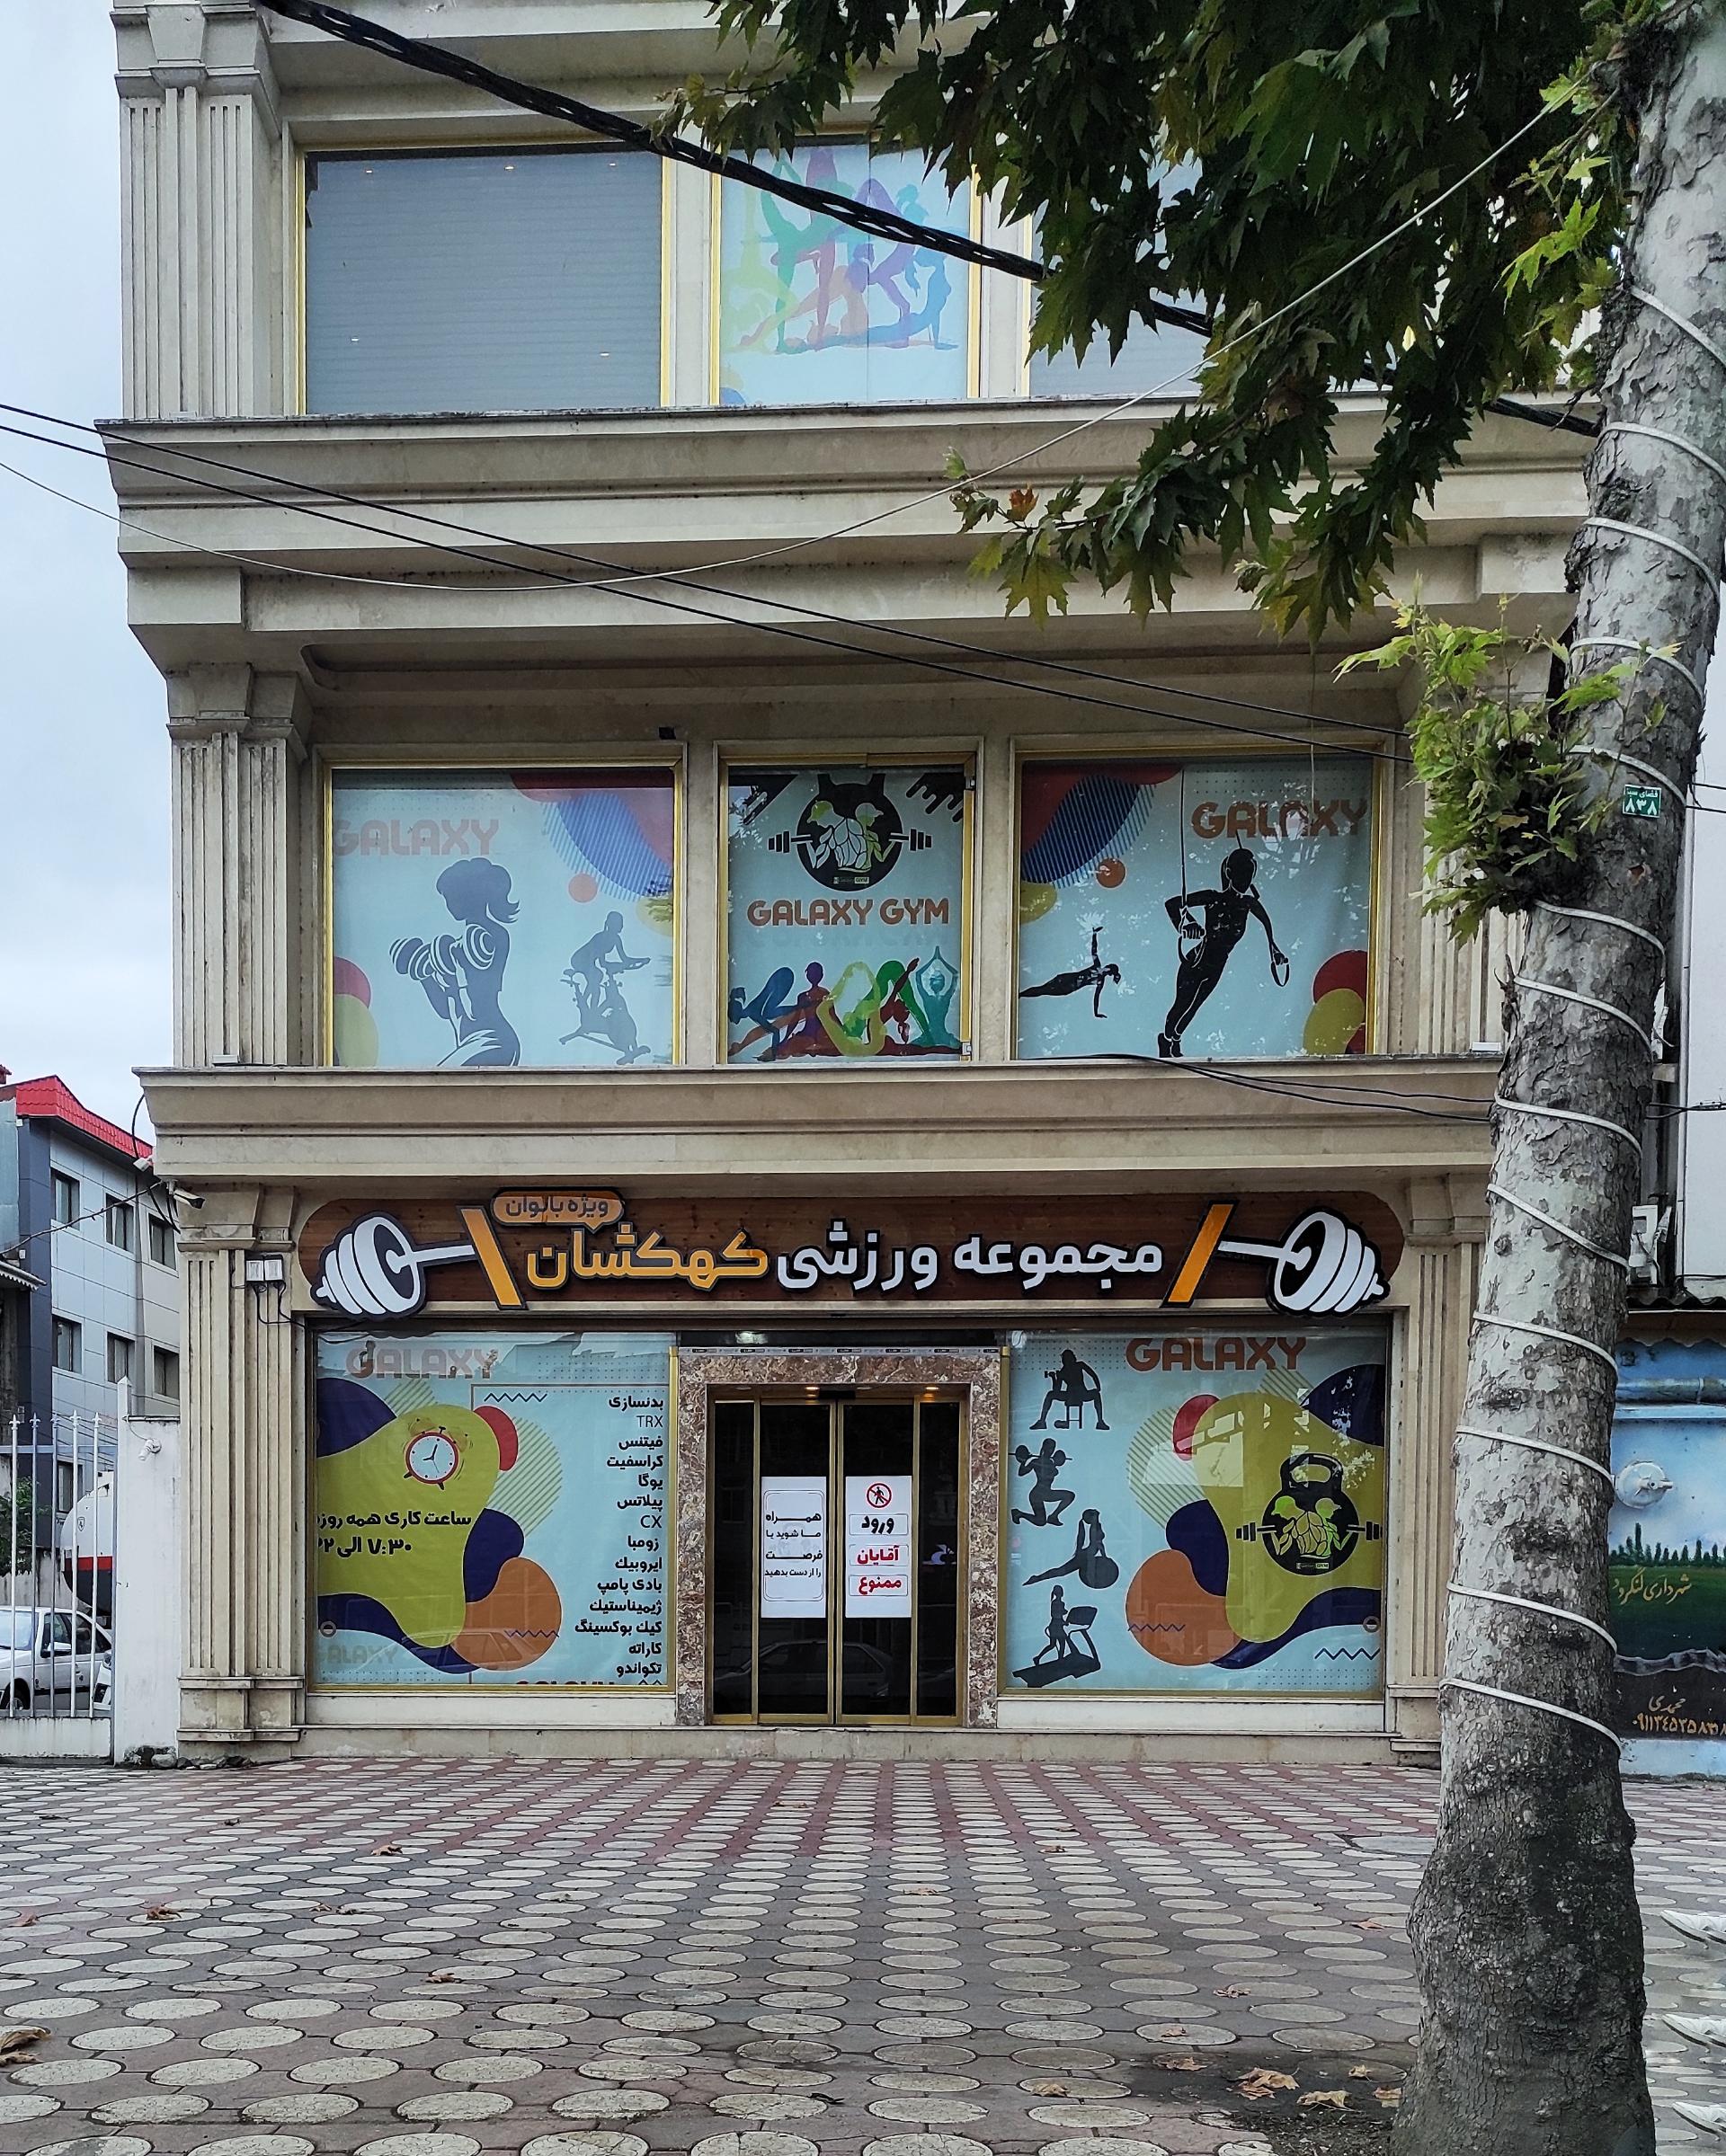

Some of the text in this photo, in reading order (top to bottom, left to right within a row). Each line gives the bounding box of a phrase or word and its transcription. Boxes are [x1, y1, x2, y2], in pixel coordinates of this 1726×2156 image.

[1625, 798, 1657, 815] ۸۳۸
[1191, 799, 1367, 838] GALAXY
[334, 819, 499, 856] GALAXY
[747, 898, 949, 926] GALAXY GYM
[567, 1193, 609, 1218] ویژه
[527, 1220, 1163, 1291] مجموعه ورزشی کهکشان
[1125, 1337, 1307, 1371] GALAXY
[346, 1348, 497, 1379] GALAXY
[609, 1396, 664, 1412] بدنسازی
[636, 1415, 663, 1428] TRX
[618, 1435, 663, 1451] فیتنس
[606, 1454, 664, 1470] کراسفیت
[637, 1473, 663, 1491] یوگا
[617, 1495, 663, 1512] پیلاتس
[346, 1513, 381, 1528] همه
[384, 1510, 422, 1530] کاری
[424, 1510, 472, 1525] ساعت
[640, 1515, 663, 1529] CX
[765, 1511, 822, 1524] همراه
[861, 1515, 894, 1534] ورود
[766, 1529, 822, 1539] ما شوید یا
[336, 1536, 362, 1558] الی
[367, 1538, 412, 1556] ۷:۳۰
[627, 1535, 659, 1551] زومبا
[765, 1549, 823, 1563] فرصت
[857, 1545, 900, 1566] آقایان
[764, 1569, 788, 1577] بدهید
[807, 1567, 814, 1577] از
[815, 1567, 822, 1577] را
[597, 1577, 663, 1595] بادی پامپ
[859, 1575, 902, 1594] ممنوع
[1612, 1566, 1692, 1605] شهرداری لنگرود
[574, 1619, 633, 1637] بوکسینگ
[628, 1642, 663, 1657] کاراته
[616, 1662, 663, 1678] تکواندو
